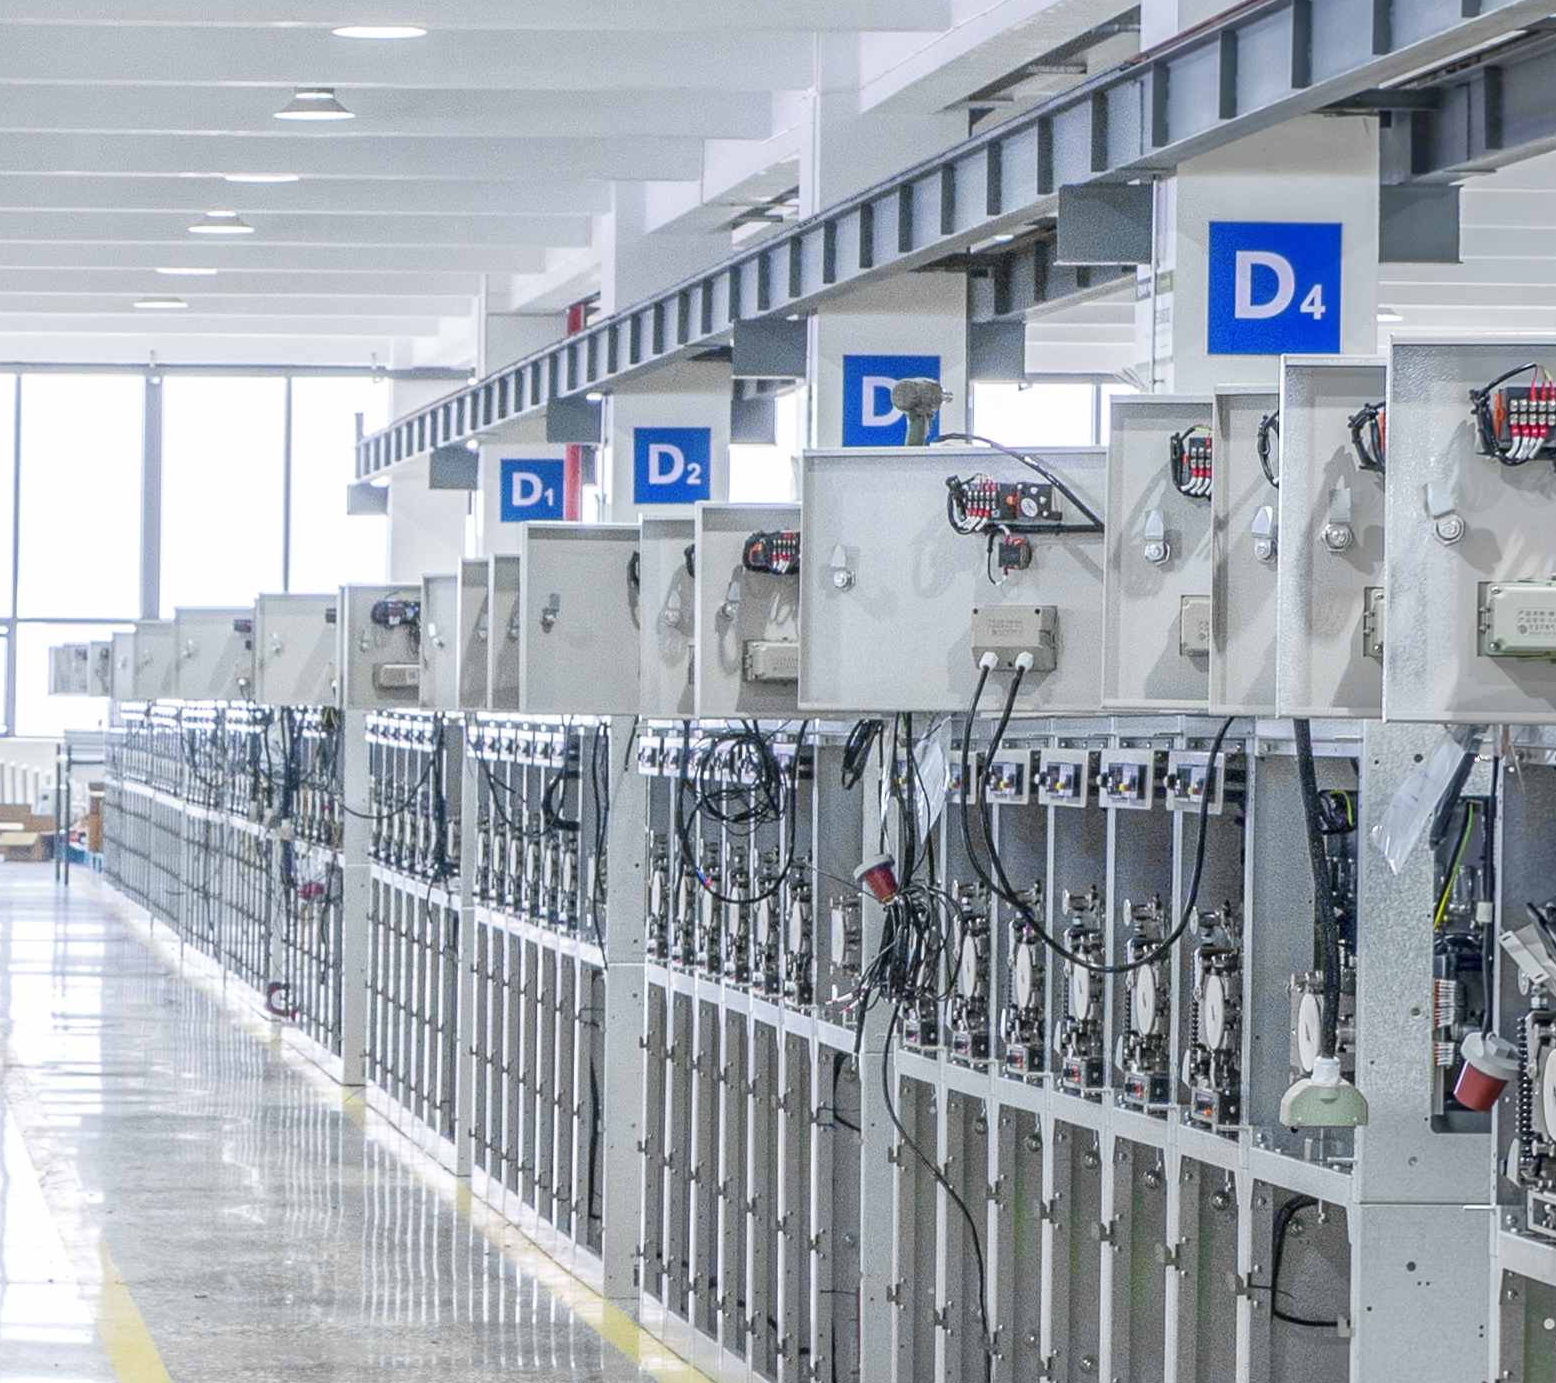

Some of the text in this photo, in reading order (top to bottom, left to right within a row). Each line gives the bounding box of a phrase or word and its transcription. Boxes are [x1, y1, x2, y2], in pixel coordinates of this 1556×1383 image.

[1234, 250, 1327, 321] D4
[861, 375, 906, 428] D
[648, 443, 703, 486] D2
[511, 471, 555, 508] D1
